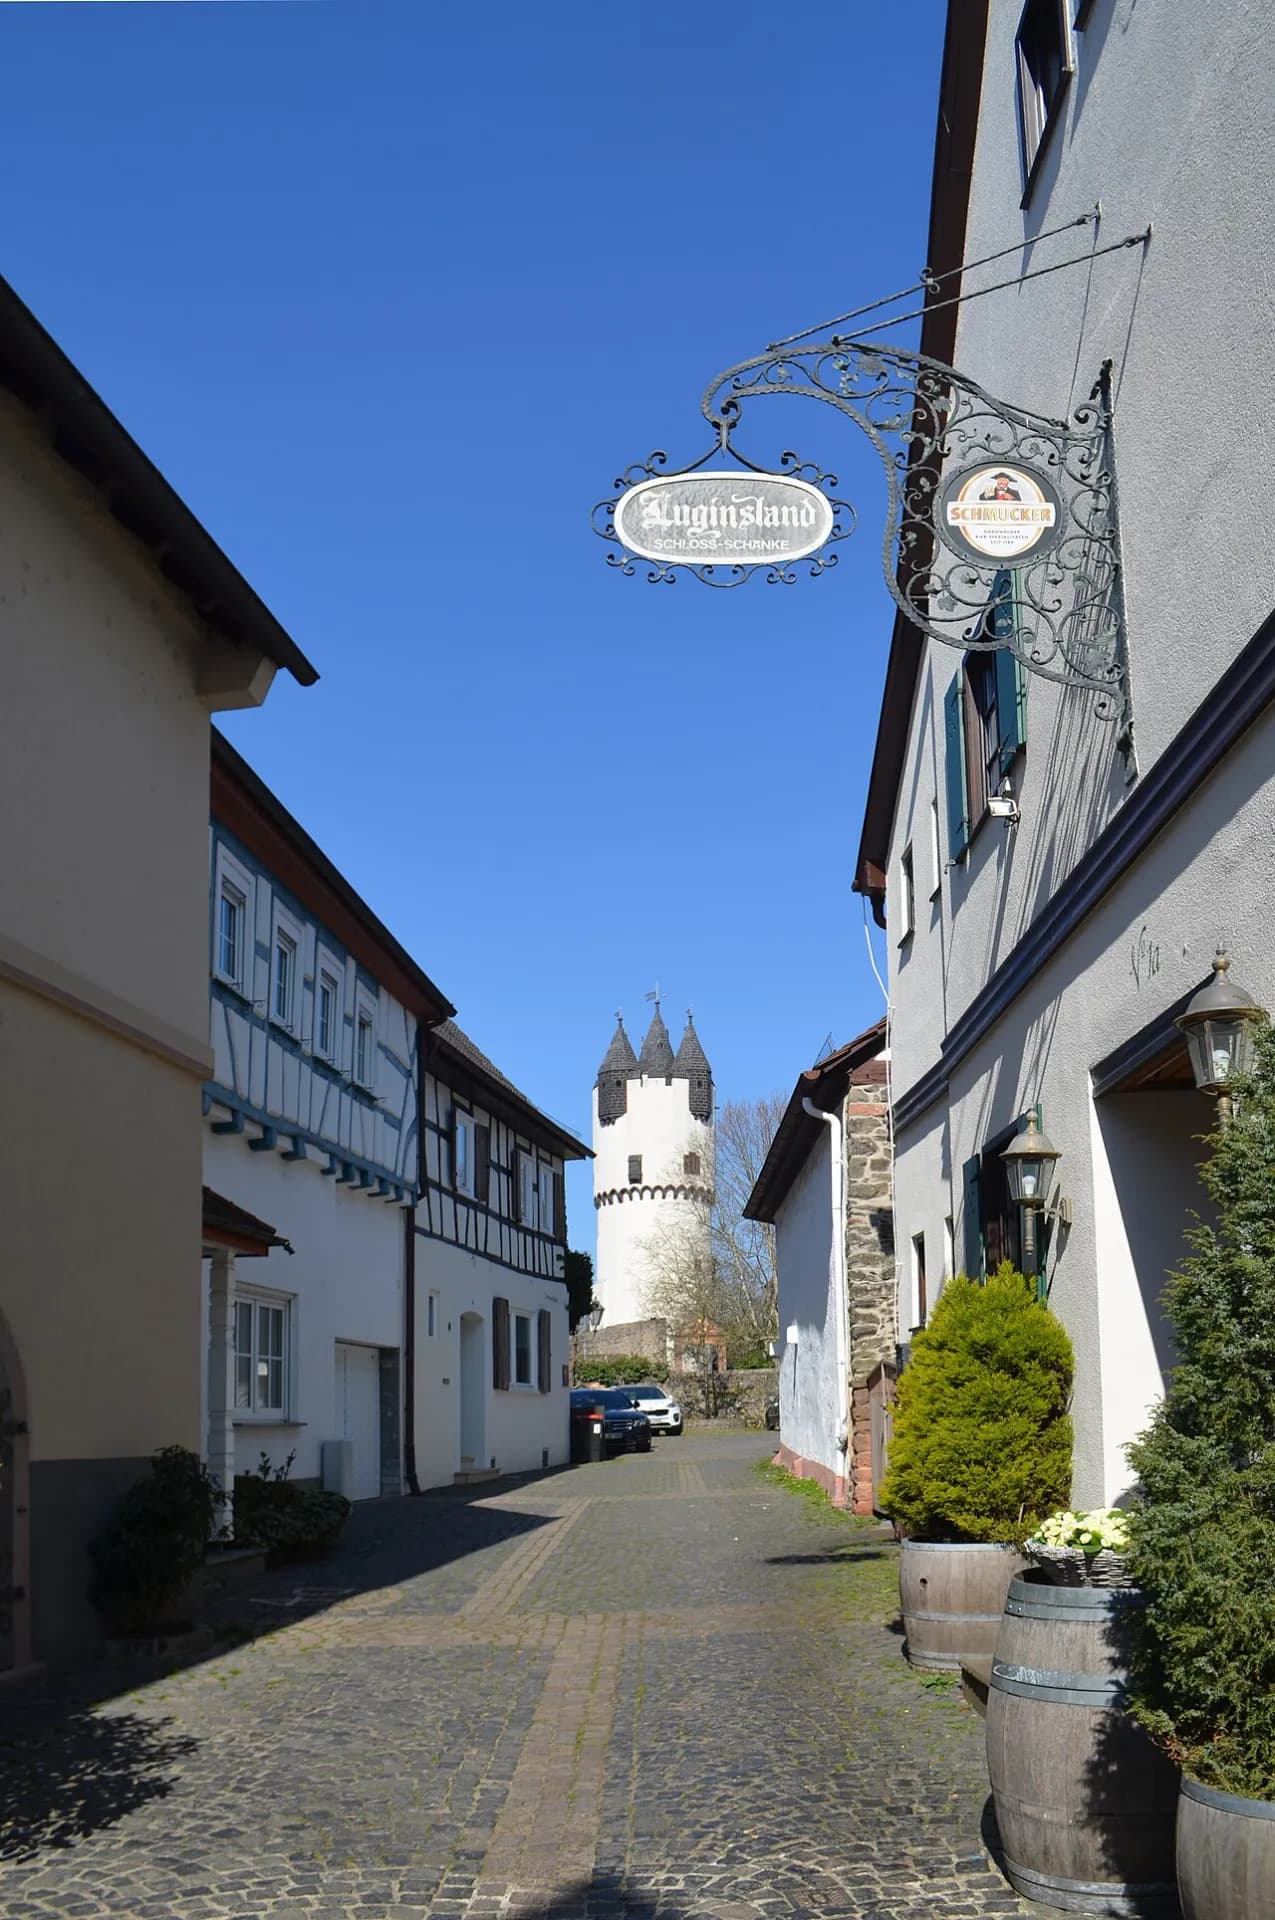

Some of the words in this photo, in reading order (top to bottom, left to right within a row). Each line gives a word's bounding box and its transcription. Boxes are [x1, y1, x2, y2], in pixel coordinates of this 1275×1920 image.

[640, 490, 816, 538] Luginsland
[950, 506, 1052, 522] SCHMUCKER
[654, 538, 790, 551] SCHLOSS-SCHÄNKE
